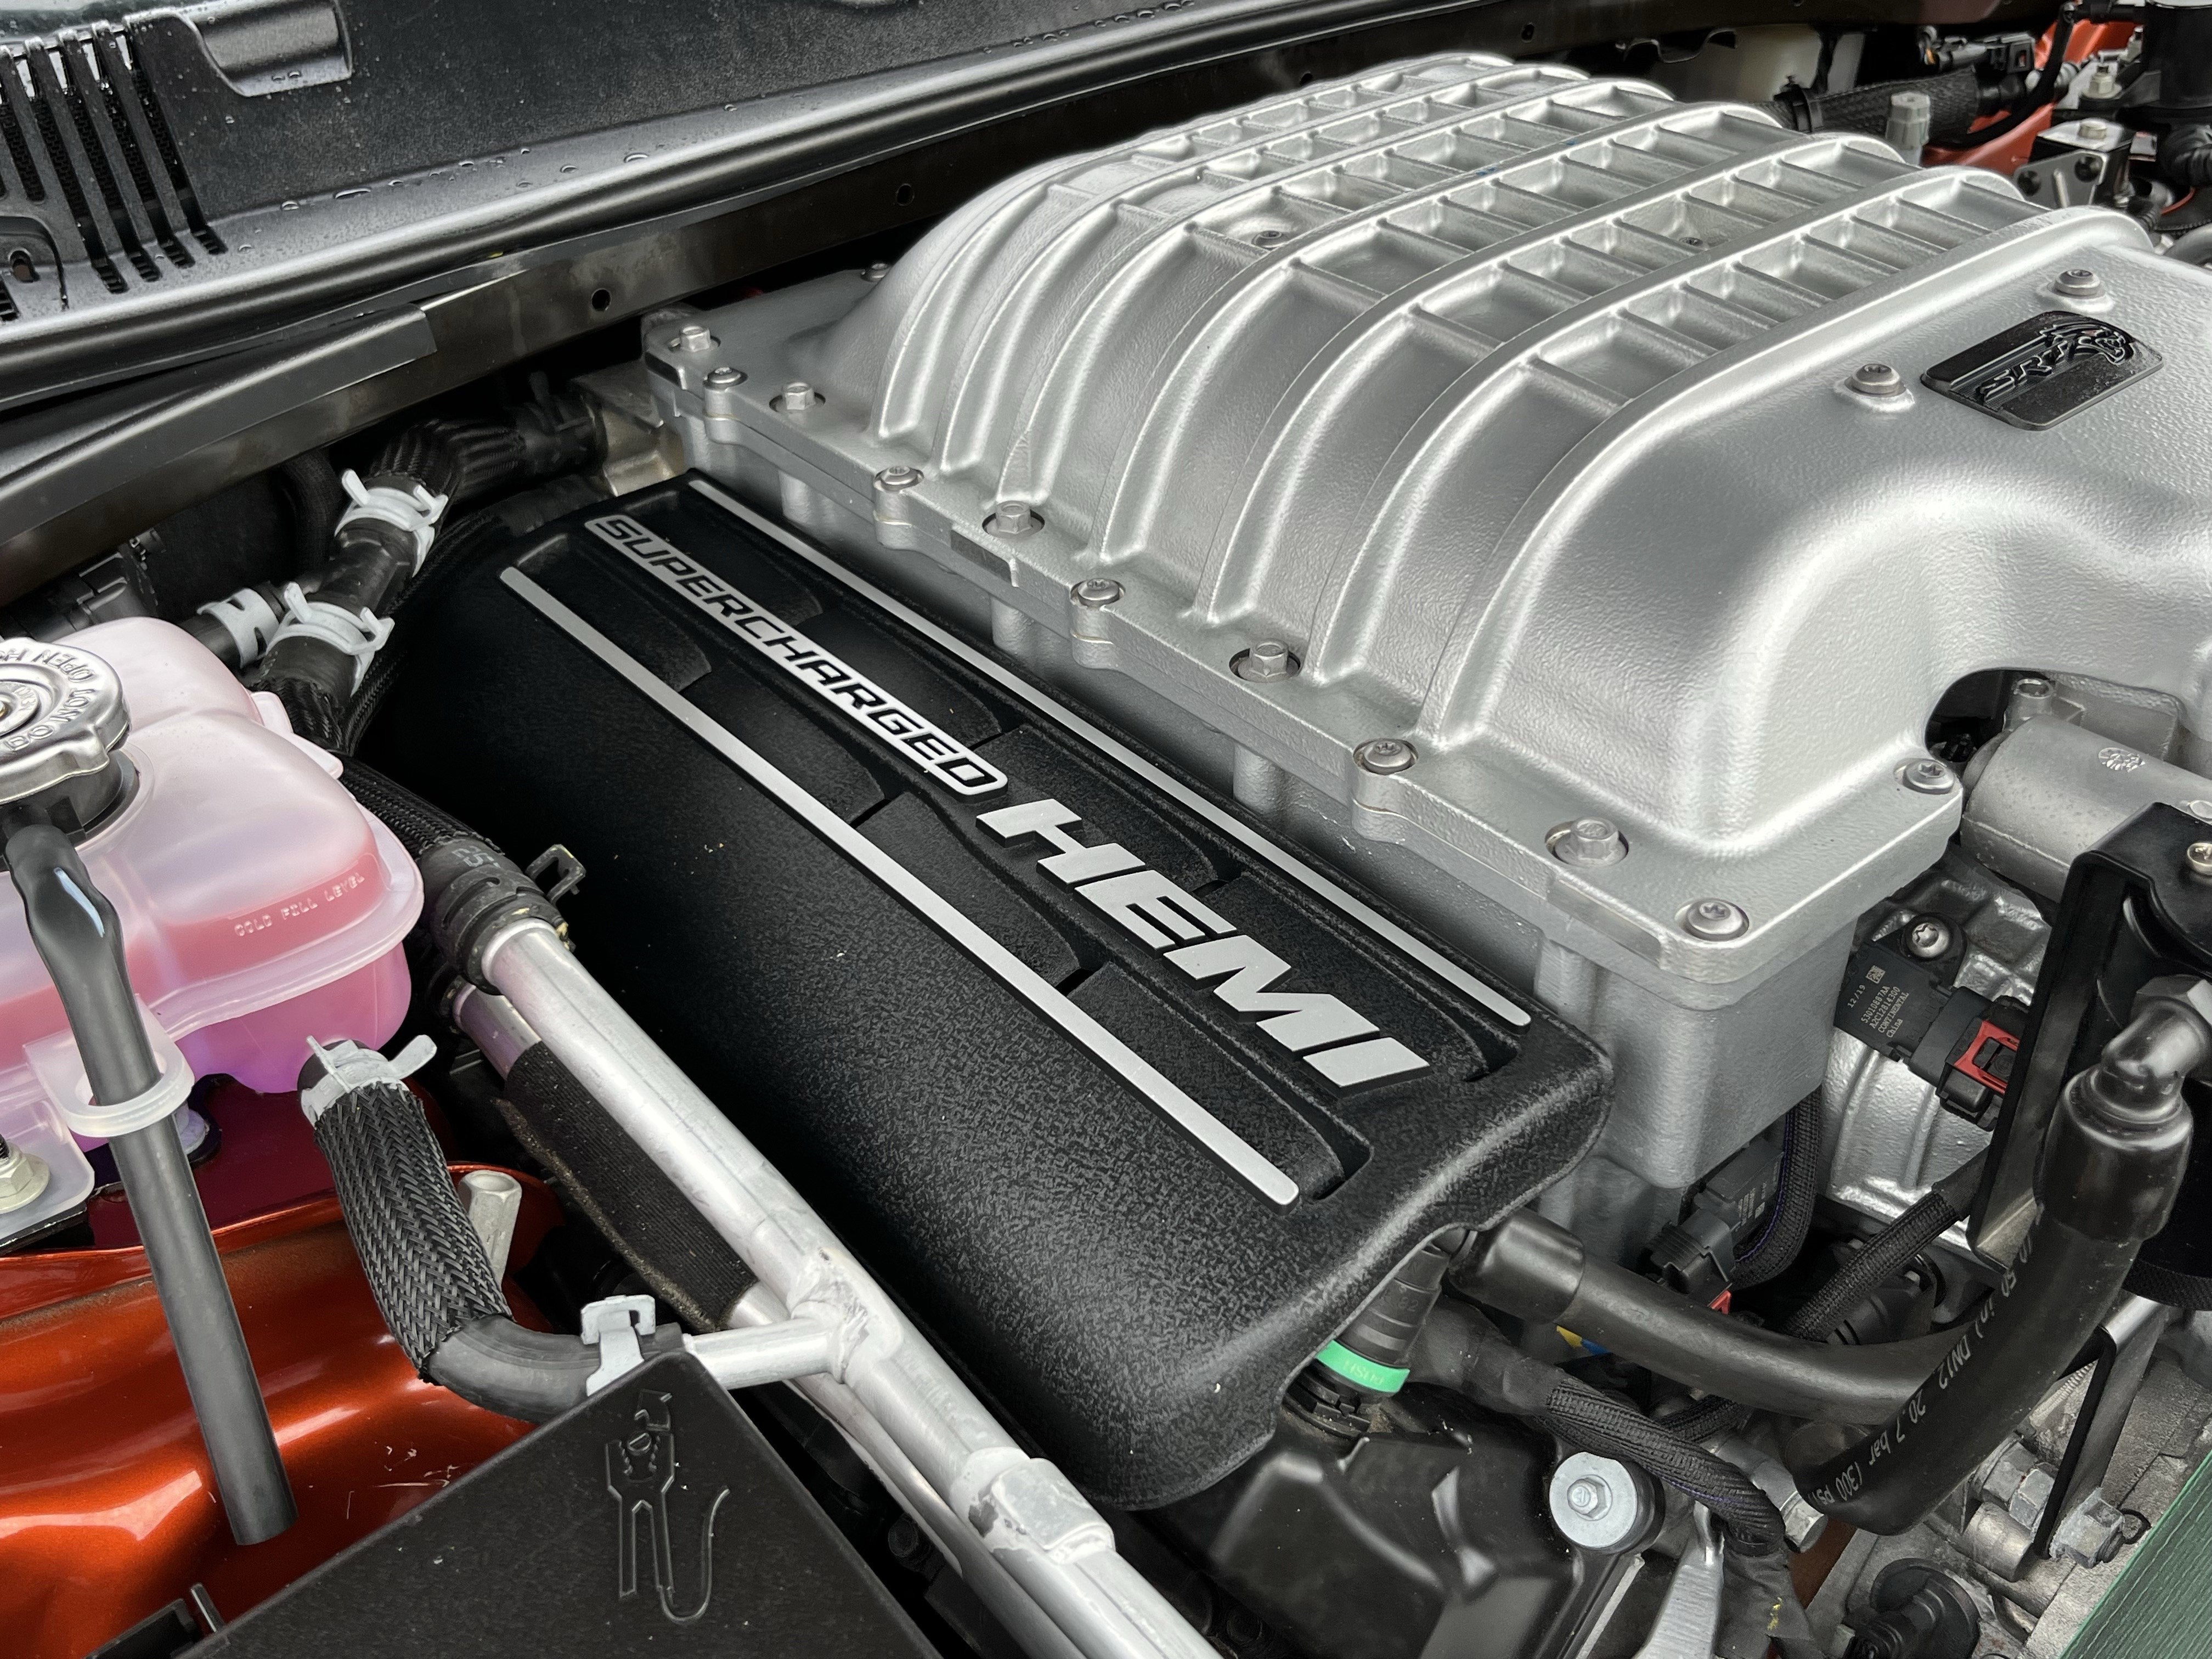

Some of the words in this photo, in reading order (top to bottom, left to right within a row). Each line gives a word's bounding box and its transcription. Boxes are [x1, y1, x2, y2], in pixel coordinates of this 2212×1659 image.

[32, 649, 95, 683] OPEN
[595, 518, 998, 788] SUPERCHARGED
[50, 687, 96, 723] NOT
[4, 724, 54, 752] DO
[234, 914, 273, 936] COLD
[280, 898, 318, 920] FILL
[324, 872, 365, 901] LEVEL
[977, 799, 1430, 1088] HEMI
[1847, 985, 1865, 1008] 12/19
[1878, 992, 1909, 1033] CONTINENTAL
[1886, 1018, 1903, 1038] China
[1939, 1335, 1971, 1390] DN12
[1896, 1390, 1926, 1444] 20.7
[1869, 1430, 1891, 1466] bar
[1835, 1462, 1863, 1501] (300
